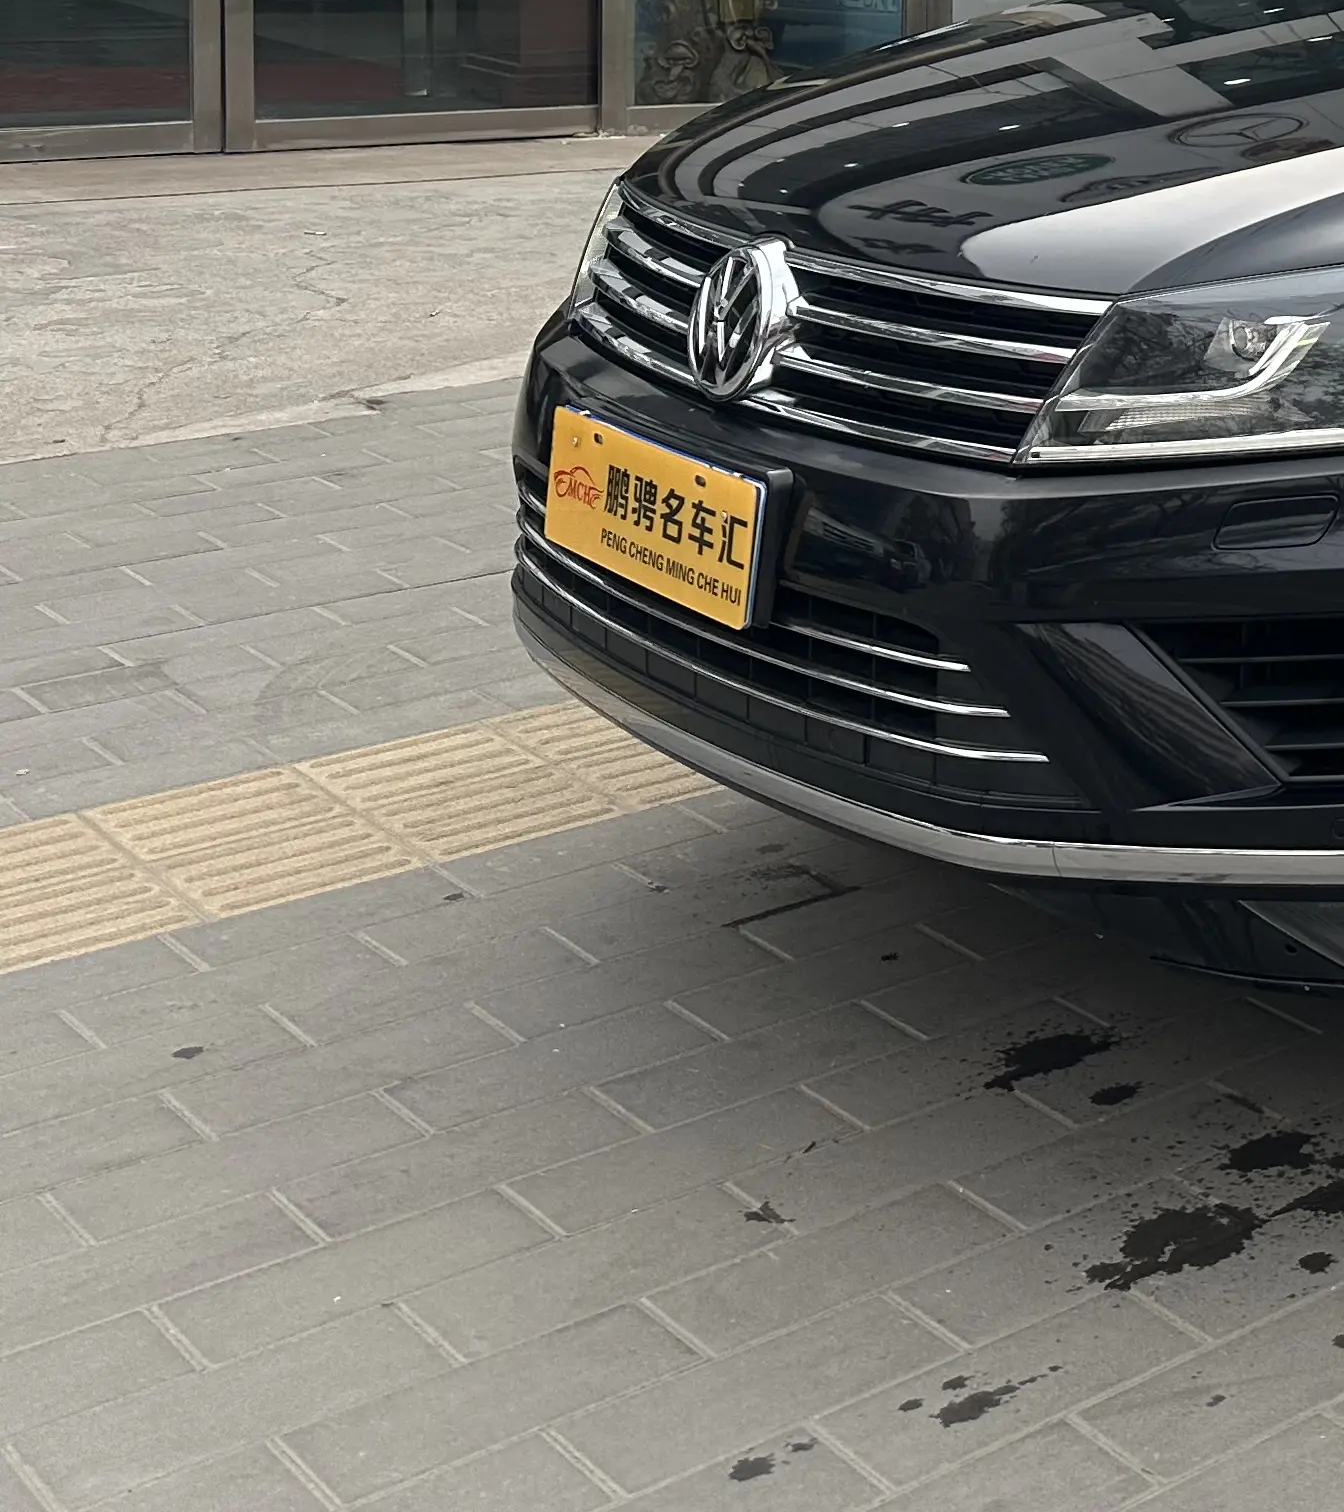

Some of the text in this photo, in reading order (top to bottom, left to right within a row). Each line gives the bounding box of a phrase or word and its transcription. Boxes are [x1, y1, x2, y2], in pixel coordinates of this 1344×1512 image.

[604, 464, 748, 570] 鹏骋名车汇
[600, 527, 741, 607] PENG CHENG MING CHE HUI
